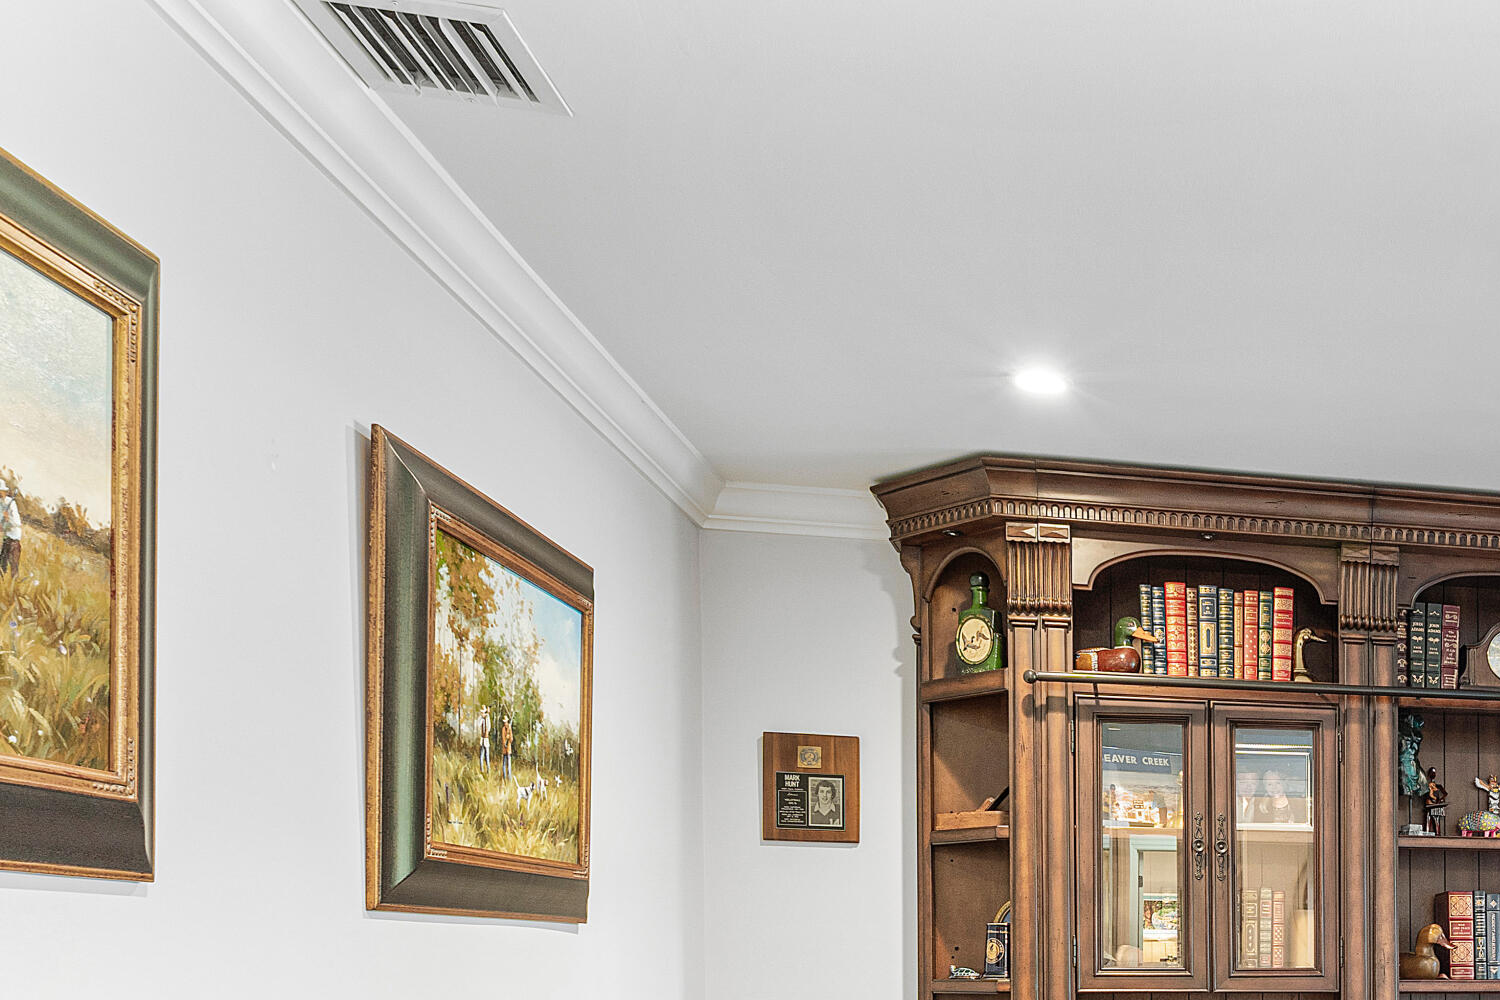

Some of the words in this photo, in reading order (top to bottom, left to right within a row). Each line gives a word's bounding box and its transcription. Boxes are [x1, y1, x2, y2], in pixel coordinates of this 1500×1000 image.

[1103, 753, 1138, 764] EAVER
[1142, 756, 1170, 767] CREEK
[784, 780, 799, 788] HUNT
